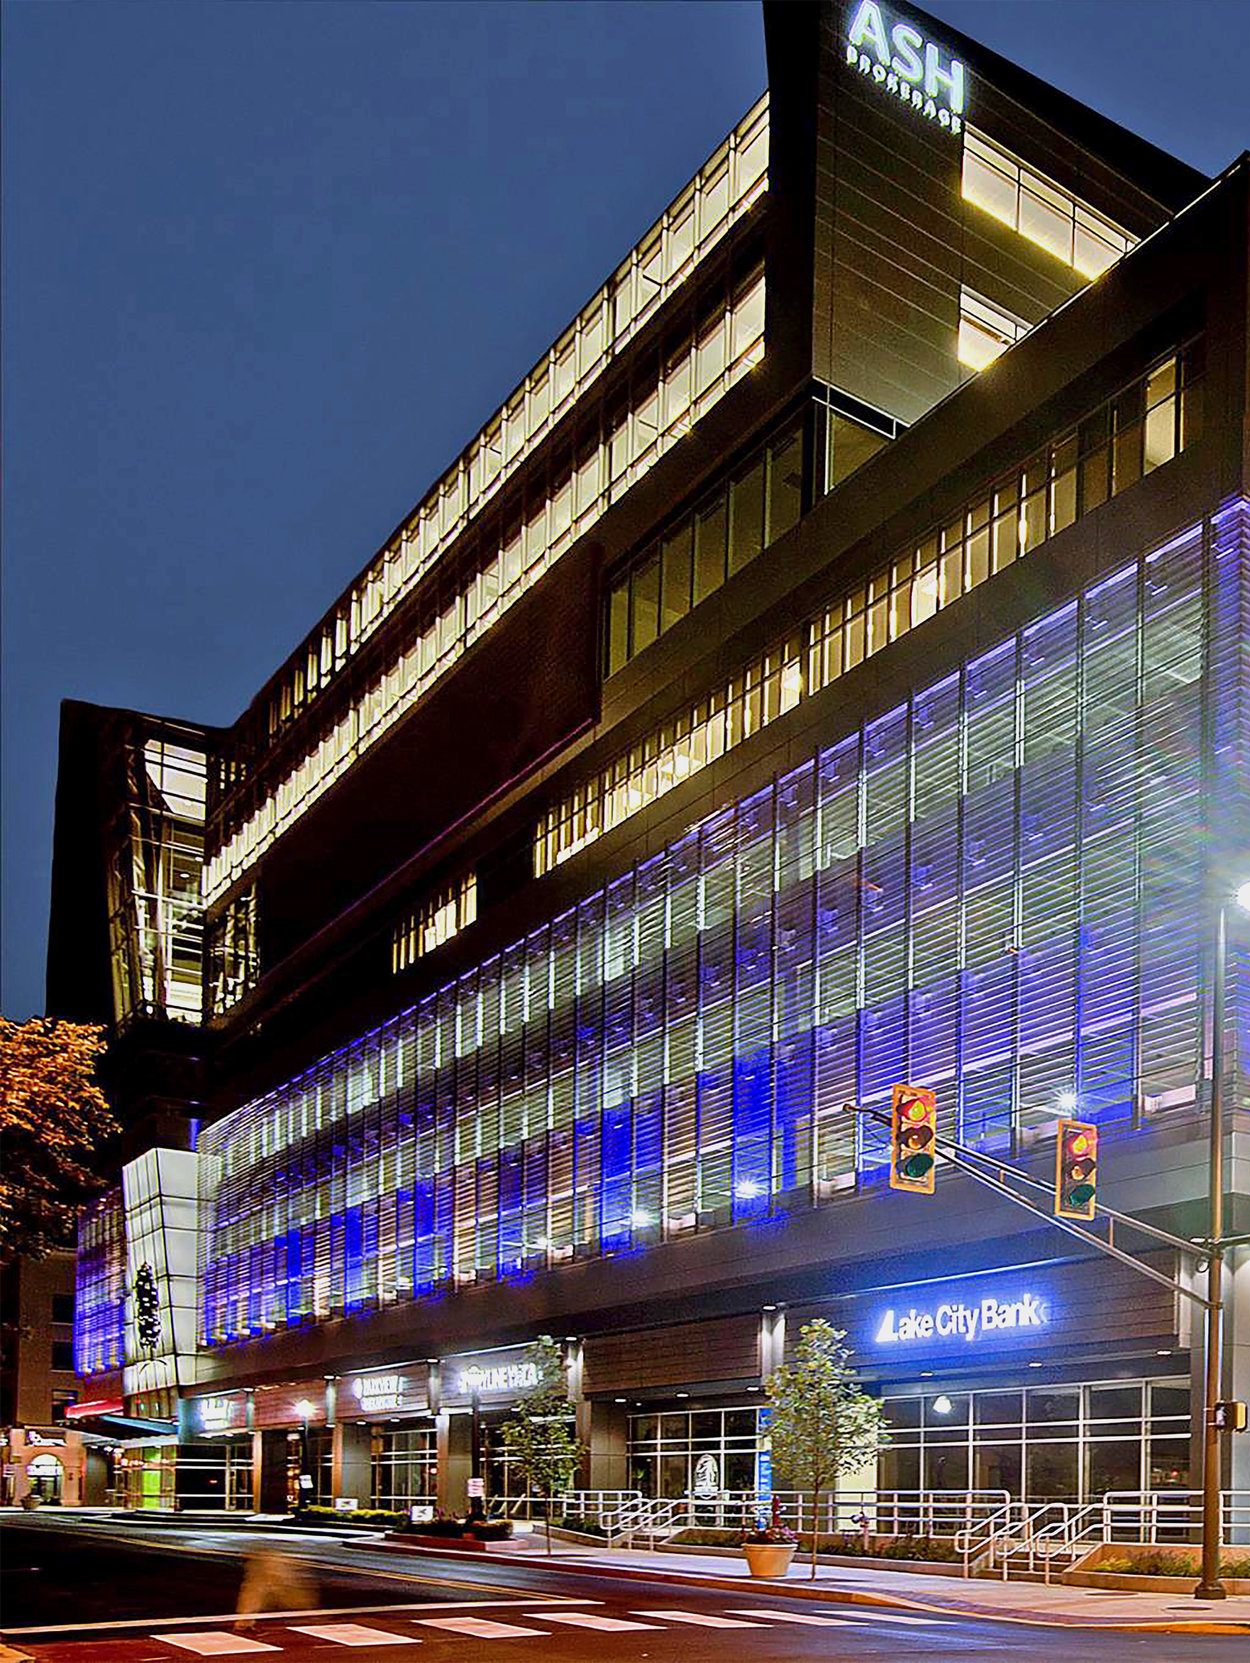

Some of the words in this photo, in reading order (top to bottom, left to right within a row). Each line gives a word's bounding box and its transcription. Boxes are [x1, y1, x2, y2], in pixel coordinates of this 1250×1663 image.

[846, 45, 962, 136] BROKERAGE
[849, 0, 964, 115] ASH
[876, 1310, 934, 1342] Lake
[936, 1305, 980, 1341] City
[981, 1294, 1041, 1330] Bank
